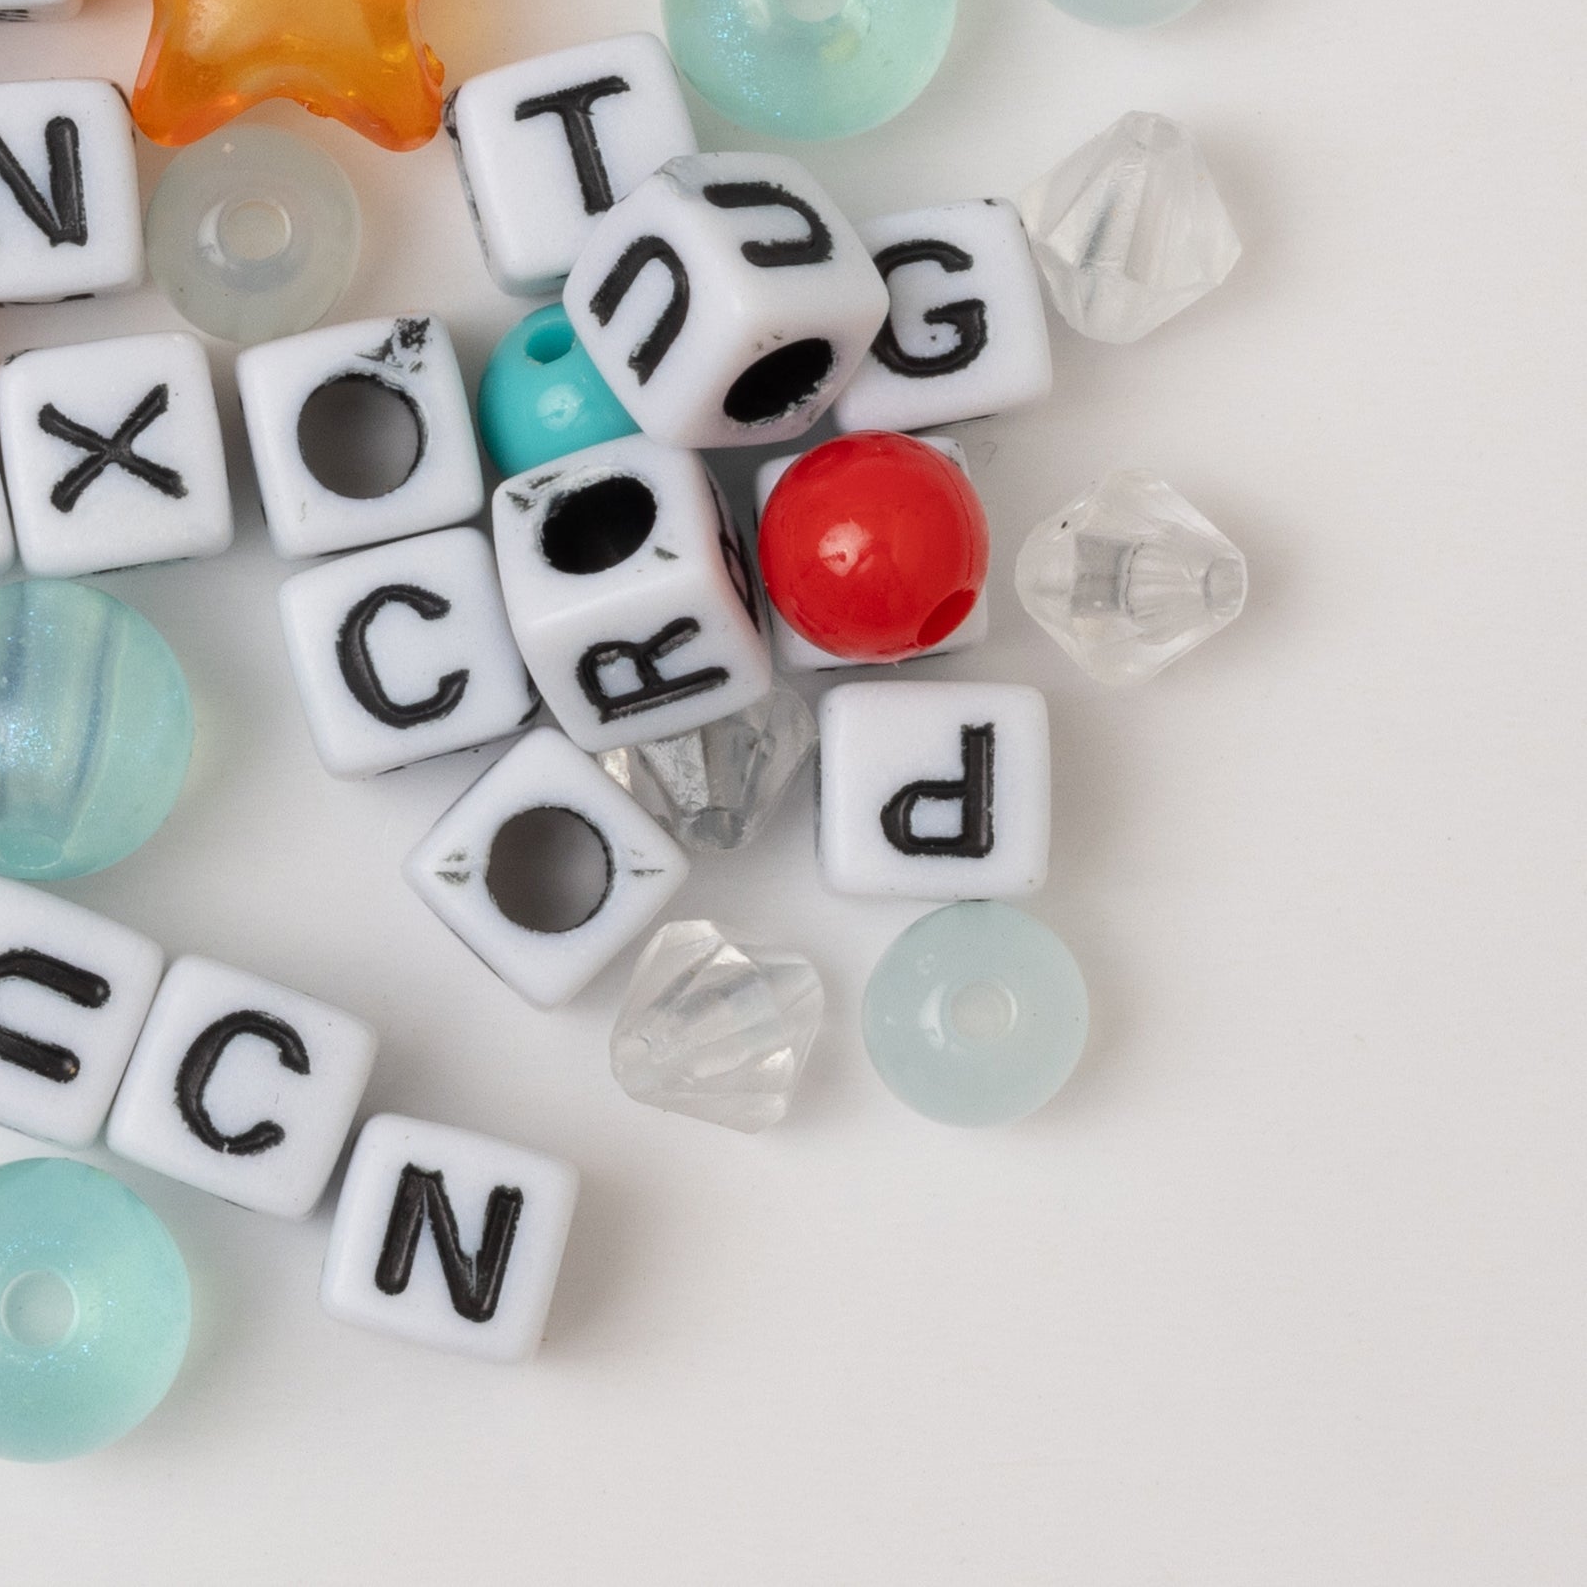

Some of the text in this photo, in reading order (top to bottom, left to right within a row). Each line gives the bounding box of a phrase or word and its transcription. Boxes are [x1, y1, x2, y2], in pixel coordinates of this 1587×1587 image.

[513, 74, 632, 217] T
[588, 234, 691, 387] U
[866, 237, 989, 381] G
[36, 382, 188, 514] X
[334, 582, 471, 731] C
[574, 615, 732, 726] R
[878, 721, 997, 860] P
[173, 1008, 312, 1157] C
[373, 1161, 525, 1325] N
